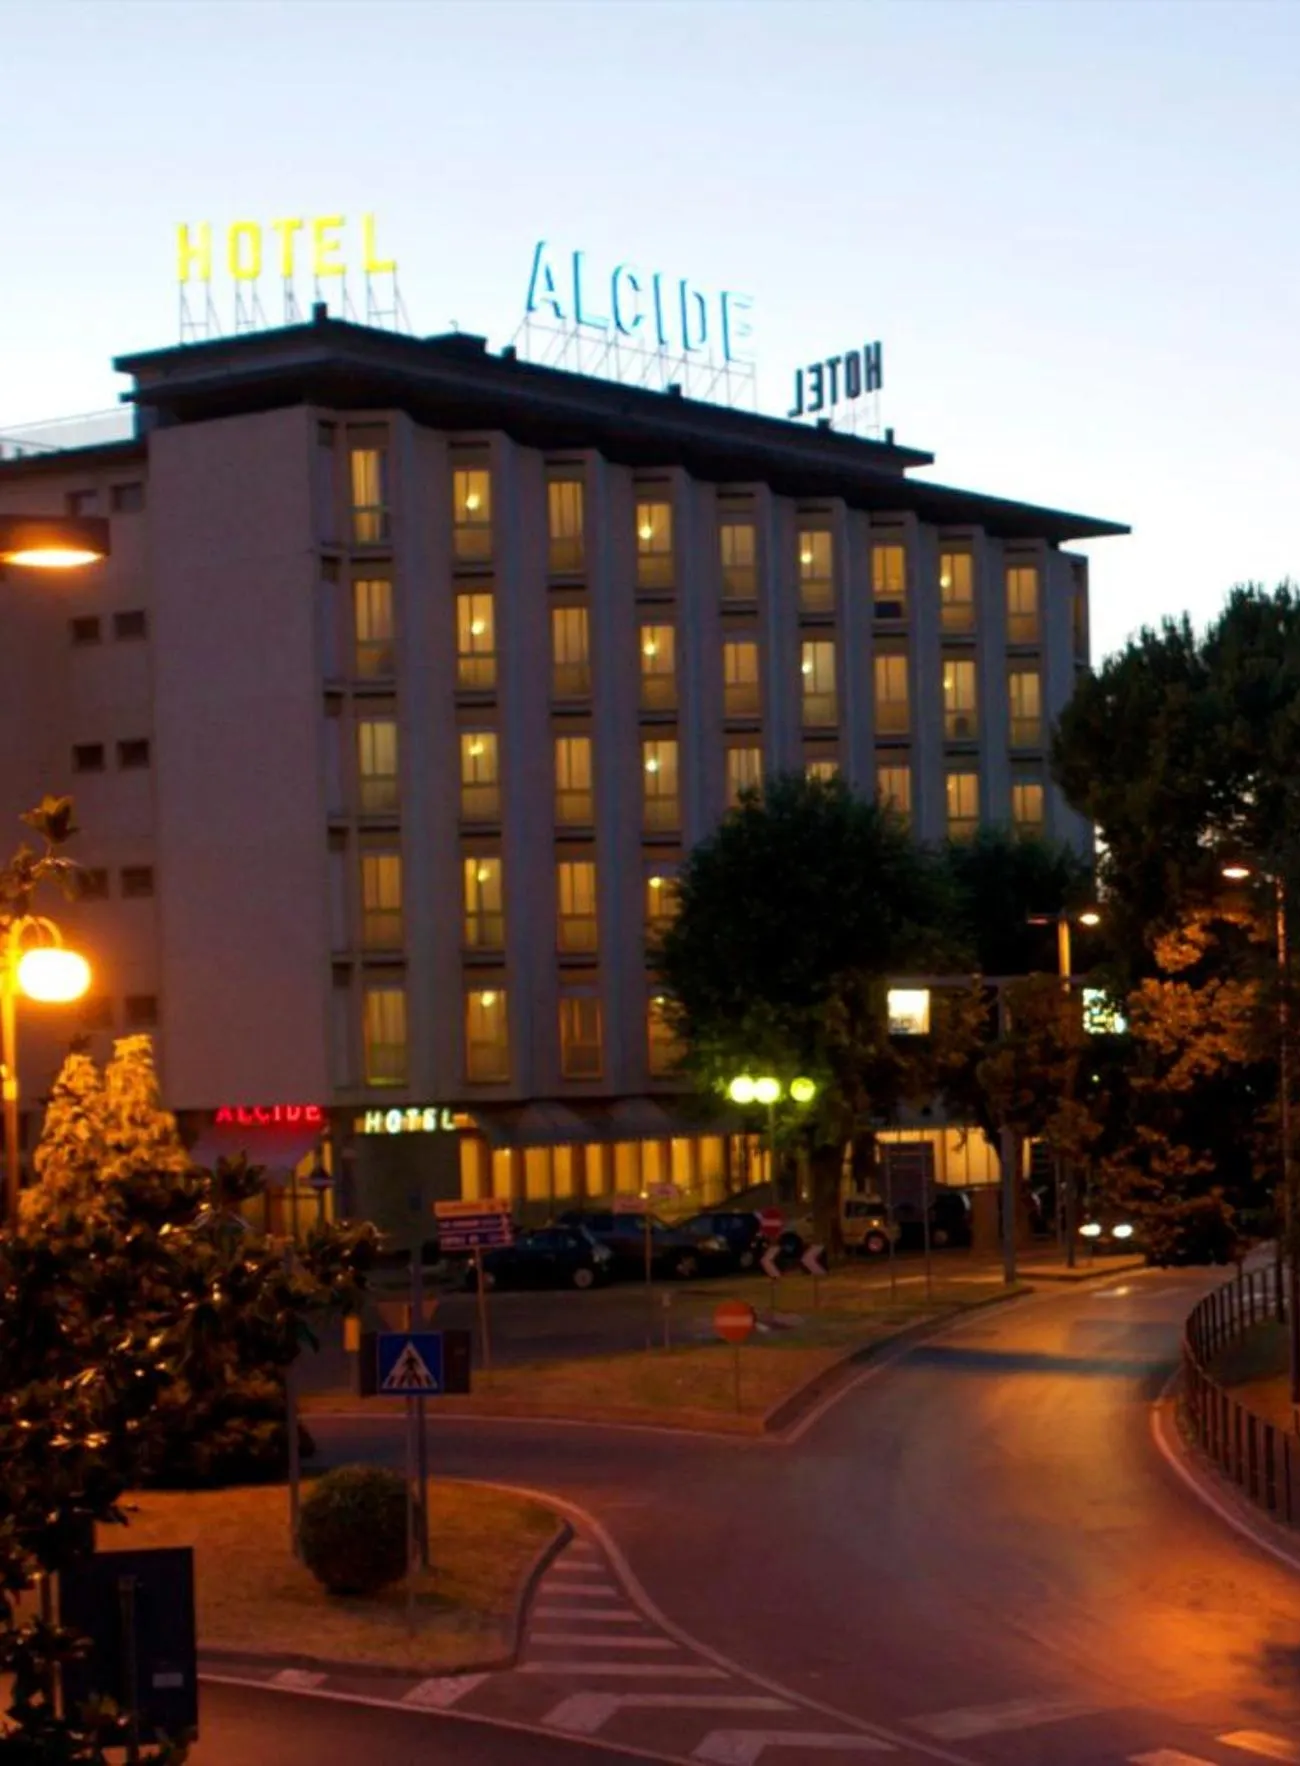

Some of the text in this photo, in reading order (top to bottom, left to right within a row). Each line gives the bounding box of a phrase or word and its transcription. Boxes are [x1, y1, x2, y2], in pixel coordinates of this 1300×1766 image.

[178, 211, 397, 285] HOTEL
[525, 240, 754, 362] ALCIDE
[215, 1104, 321, 1125] ALCIDE
[364, 1107, 456, 1134] HOTEL
